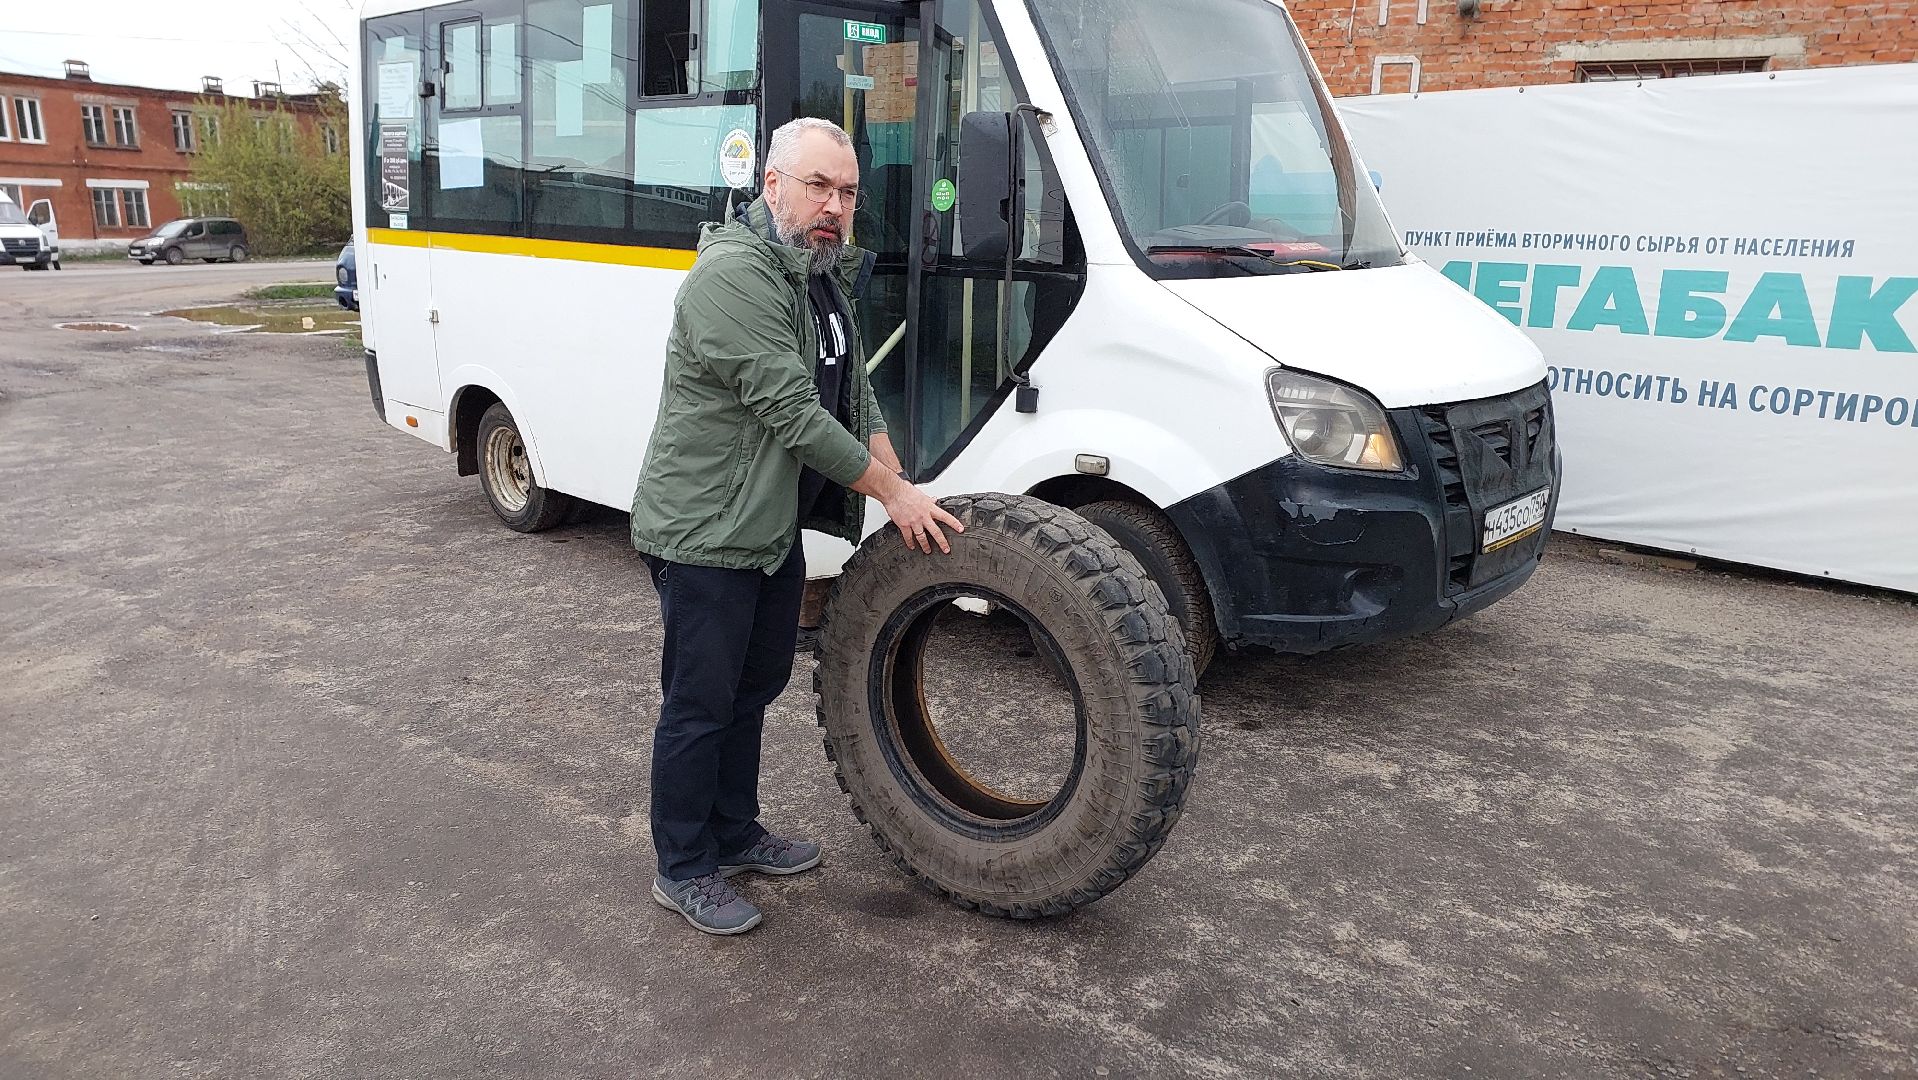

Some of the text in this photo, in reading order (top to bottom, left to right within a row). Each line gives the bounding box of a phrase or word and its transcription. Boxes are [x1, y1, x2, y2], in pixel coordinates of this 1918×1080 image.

[1404, 228, 1855, 258] ПУНКТ ПРИЁМА ВТОРИЧНОГО СЫРЬЯ ОТ НАСЕЛЕНИЯ
[1697, 379, 1738, 410] НА
